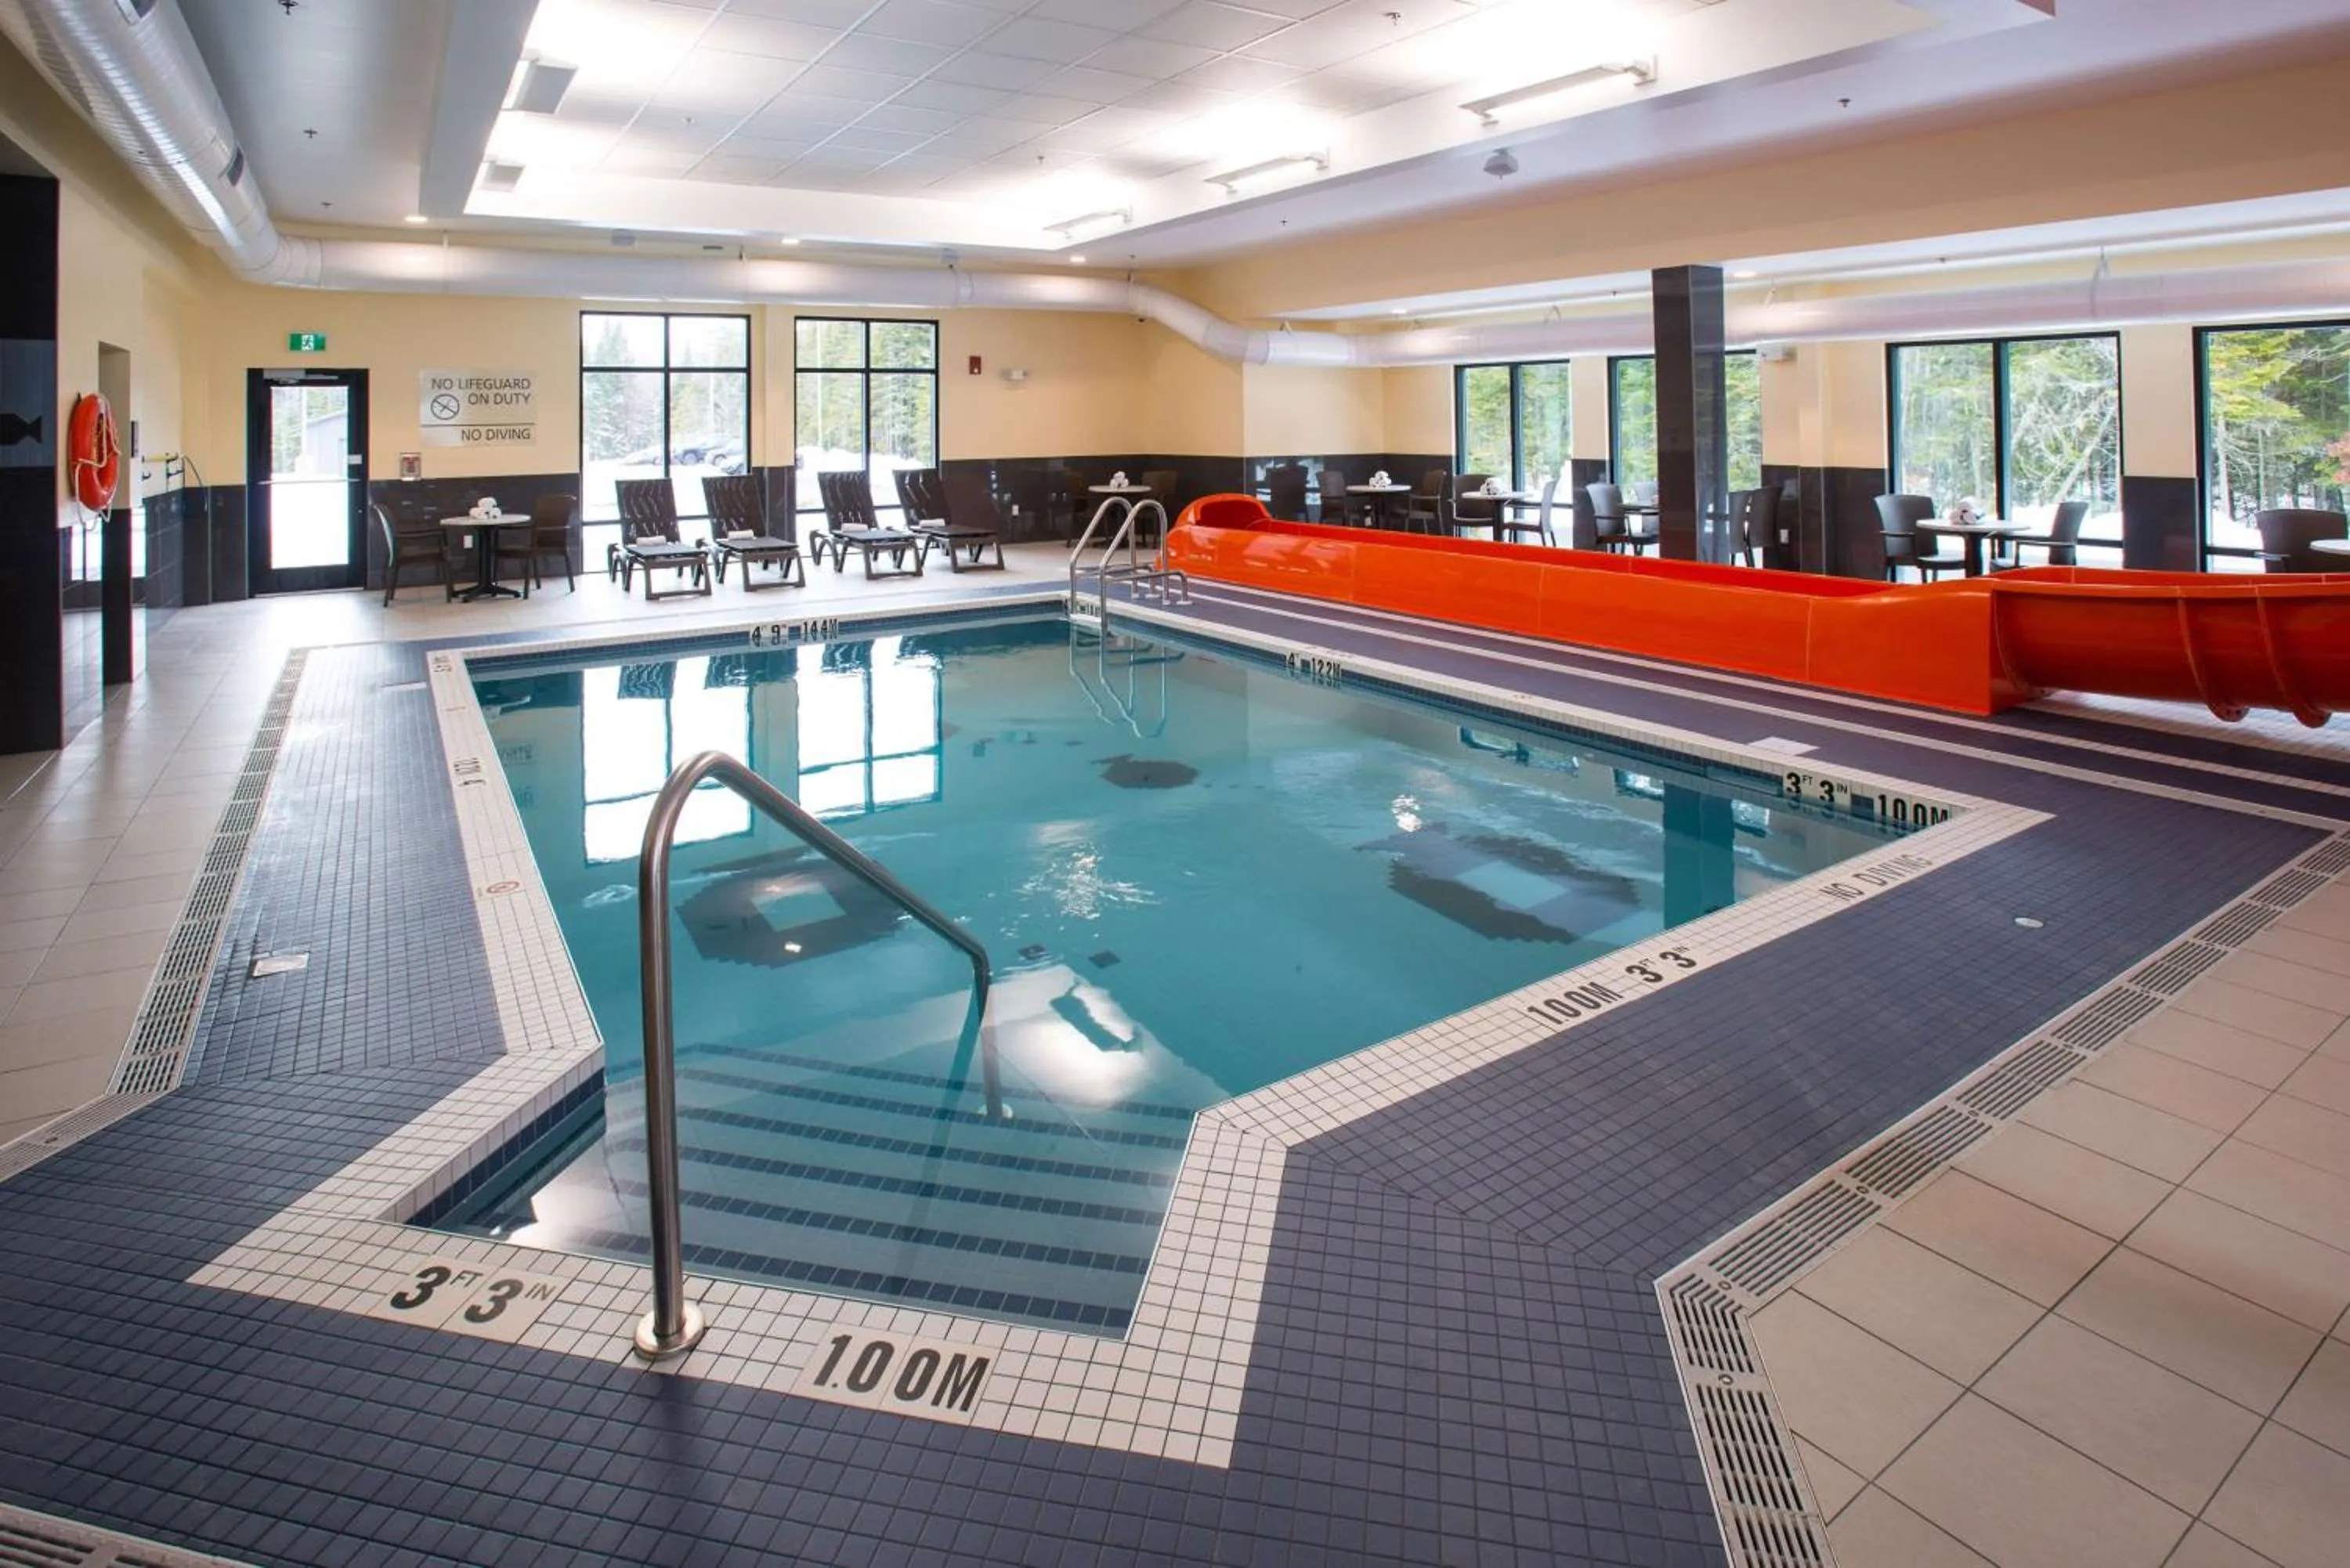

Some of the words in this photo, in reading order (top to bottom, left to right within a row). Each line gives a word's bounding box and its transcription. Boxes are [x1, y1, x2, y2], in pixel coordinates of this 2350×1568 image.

[432, 378, 454, 390] NO
[458, 378, 531, 390] LIFEGUARD
[468, 392, 490, 405] ON
[494, 393, 531, 405] DUTY
[461, 429, 482, 441] NO
[486, 428, 531, 441] DIVING
[1819, 883, 1865, 901] NO
[1853, 854, 1933, 887] DIVING
